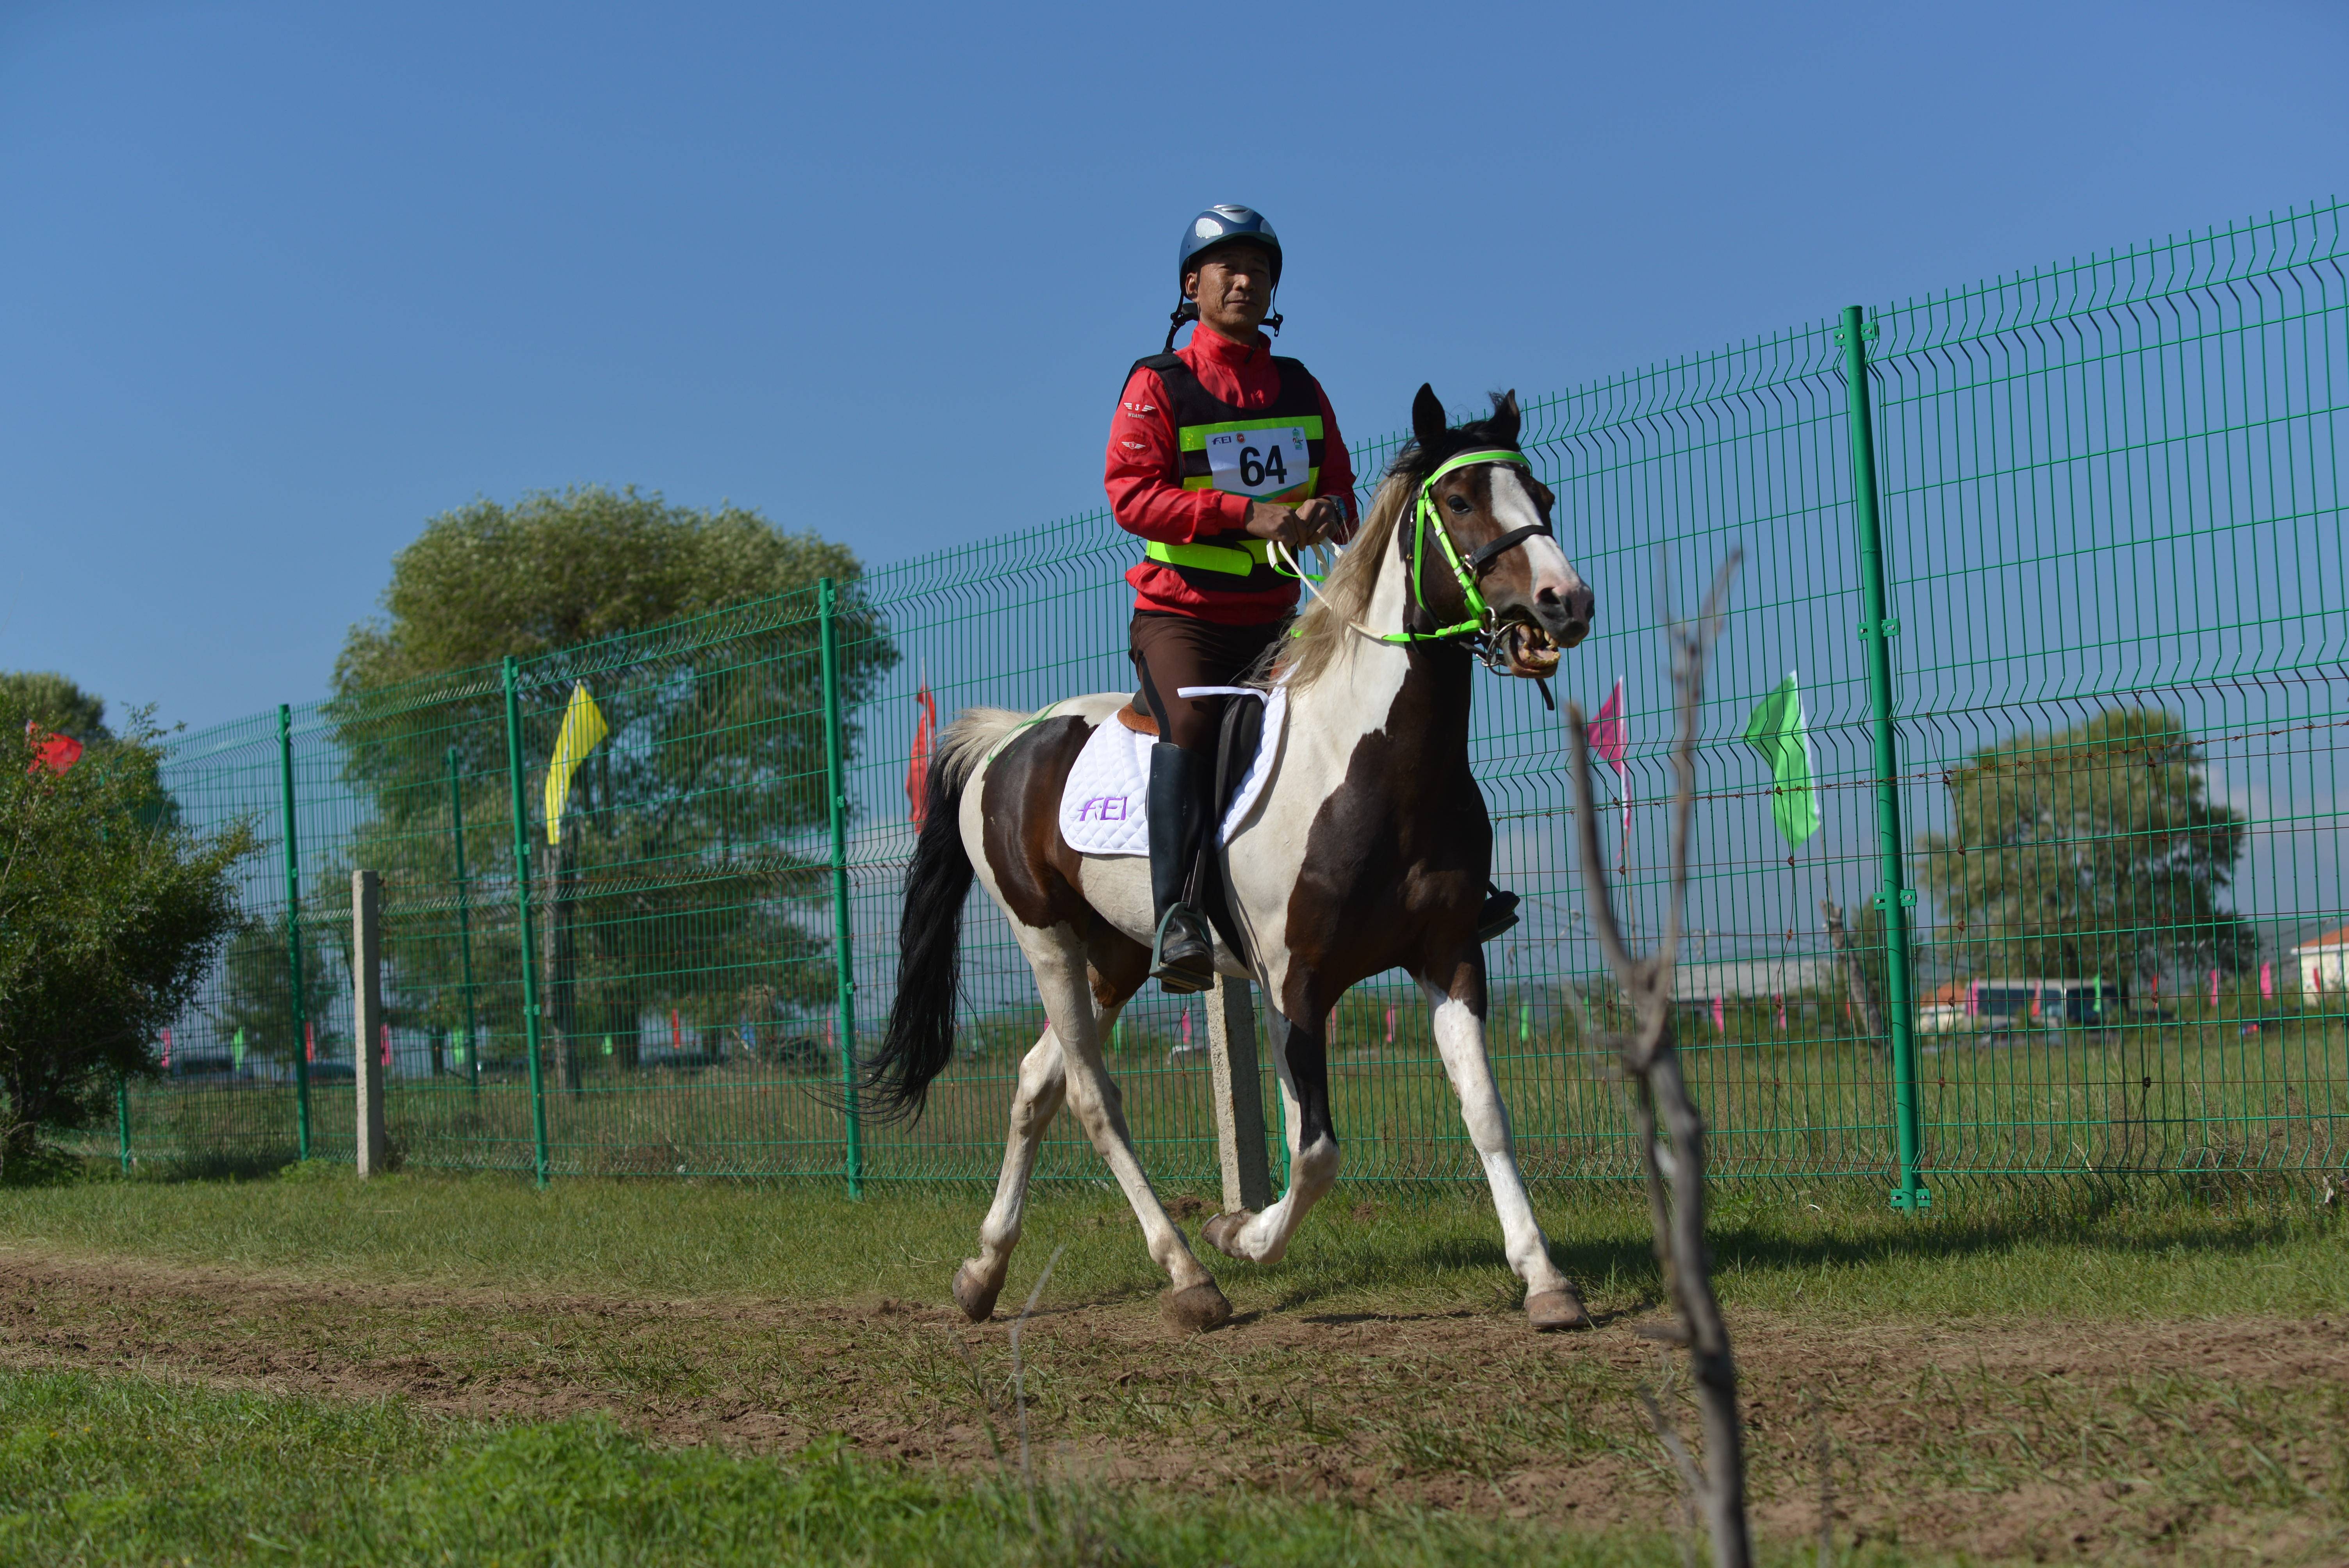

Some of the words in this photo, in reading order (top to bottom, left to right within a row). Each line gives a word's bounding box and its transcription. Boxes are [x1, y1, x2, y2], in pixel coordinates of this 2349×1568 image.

[1212, 436, 1232, 445] FEI
[1239, 445, 1287, 487] 64
[1078, 796, 1128, 821] FEI
